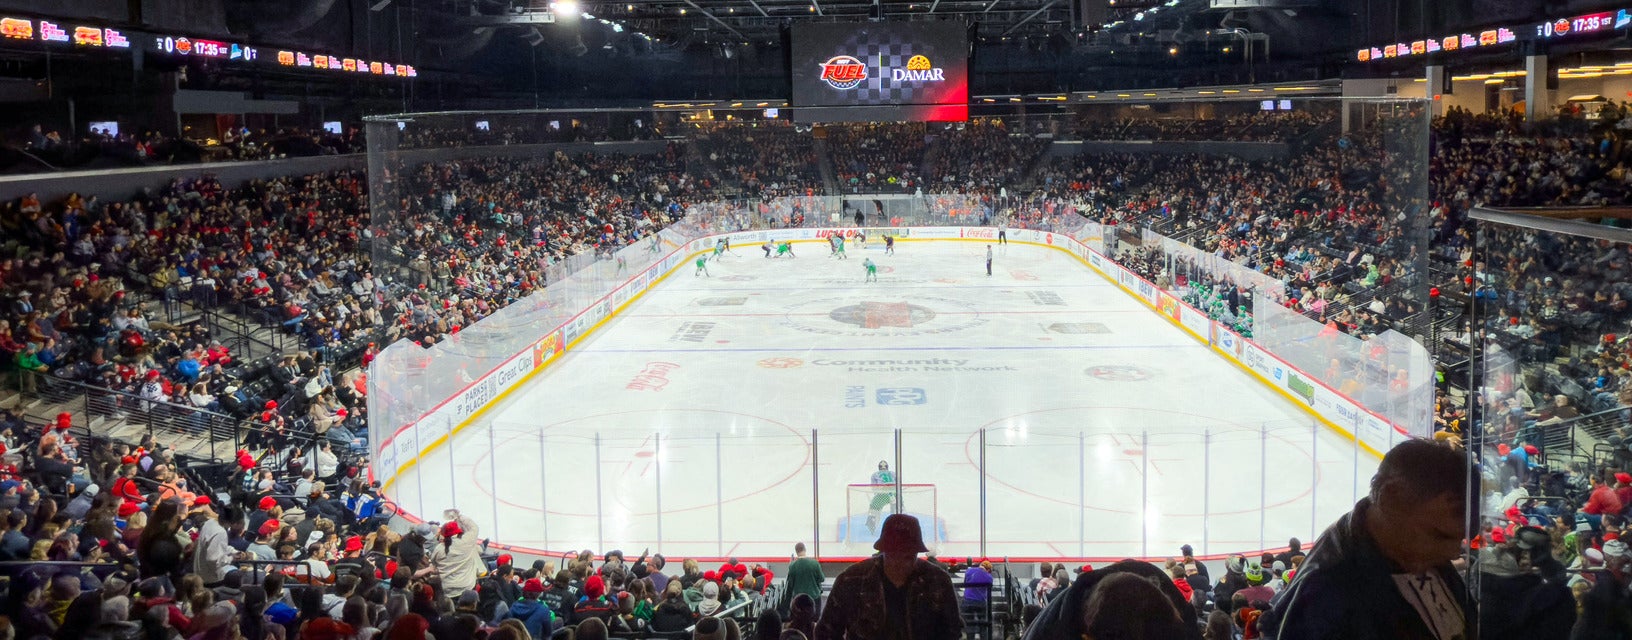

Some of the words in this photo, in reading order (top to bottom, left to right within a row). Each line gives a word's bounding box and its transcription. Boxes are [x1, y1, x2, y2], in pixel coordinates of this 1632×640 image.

[1544, 22, 1552, 37] 0
[1573, 17, 1599, 31] 17:35
[165, 36, 173, 52] 0
[194, 42, 218, 55] 17:35
[244, 46, 251, 60] 0
[822, 65, 867, 79] FUEL
[893, 68, 945, 81] DAMAR
[811, 357, 968, 367] Community
[498, 366, 517, 386] Great
[519, 356, 533, 374] Clips
